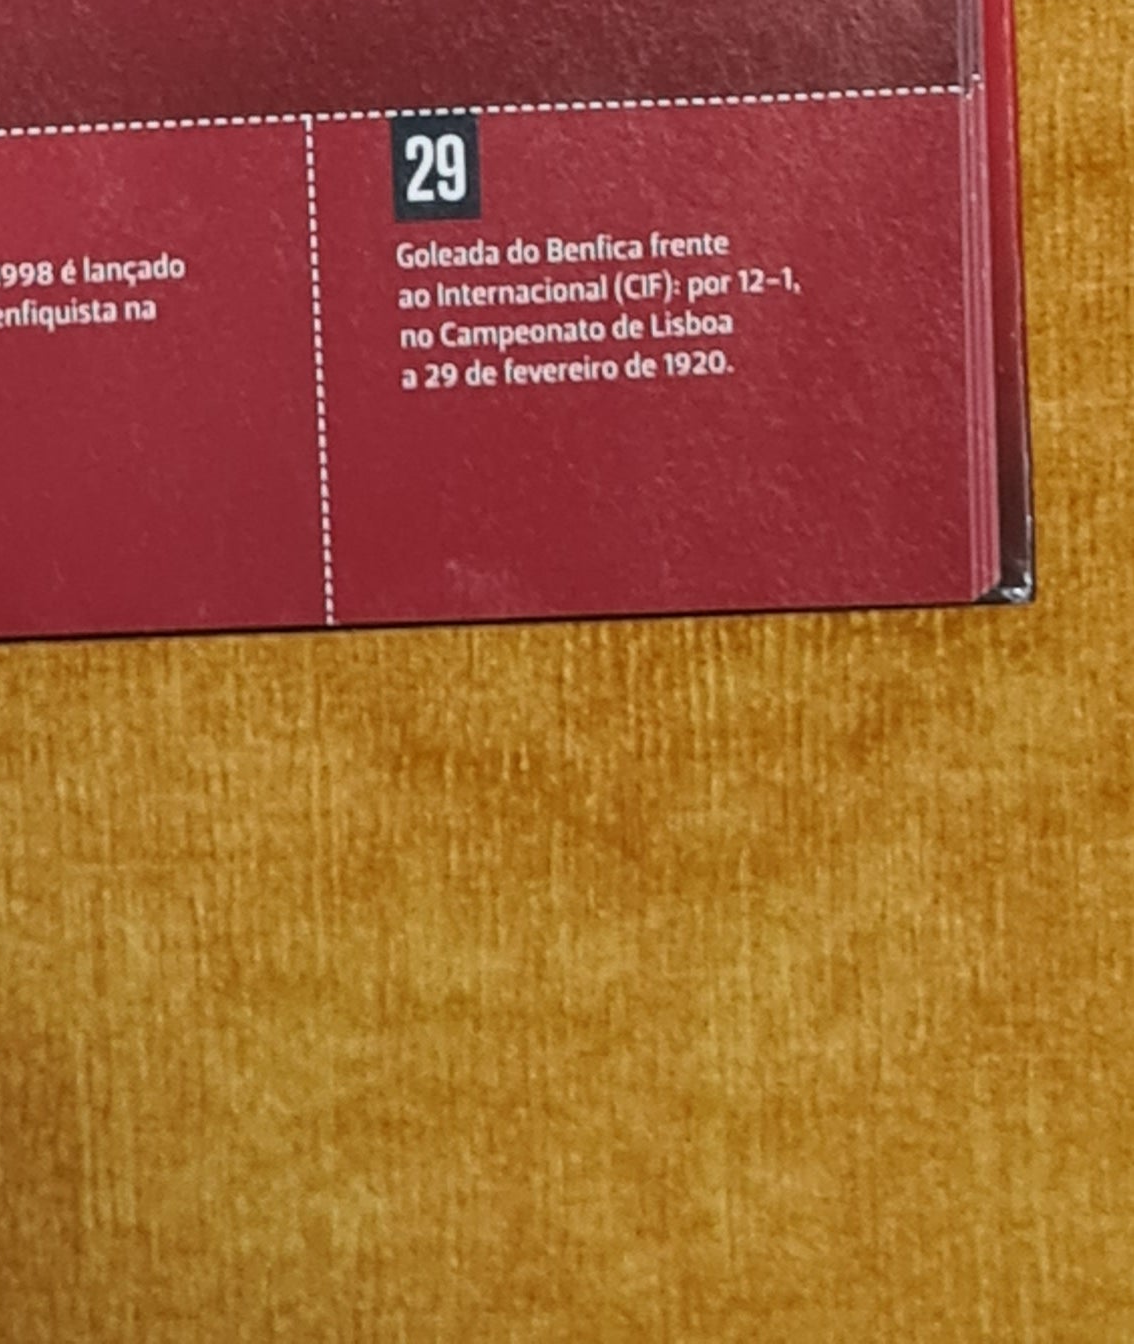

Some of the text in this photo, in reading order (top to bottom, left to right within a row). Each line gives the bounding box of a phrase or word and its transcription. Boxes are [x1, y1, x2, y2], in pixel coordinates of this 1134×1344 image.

[405, 133, 467, 203] 29
[396, 231, 729, 269] Goleada do Benfica frente
[60, 256, 76, 284] é
[83, 252, 185, 288] lançado
[399, 286, 430, 308] ao
[437, 274, 607, 307] Internacional
[614, 270, 680, 305] (CIF):
[688, 273, 729, 303] por
[125, 300, 156, 320] na
[401, 309, 733, 352] no Campeonato de Lisboa
[402, 350, 734, 389] a 29 de fevereiro de 1920.
